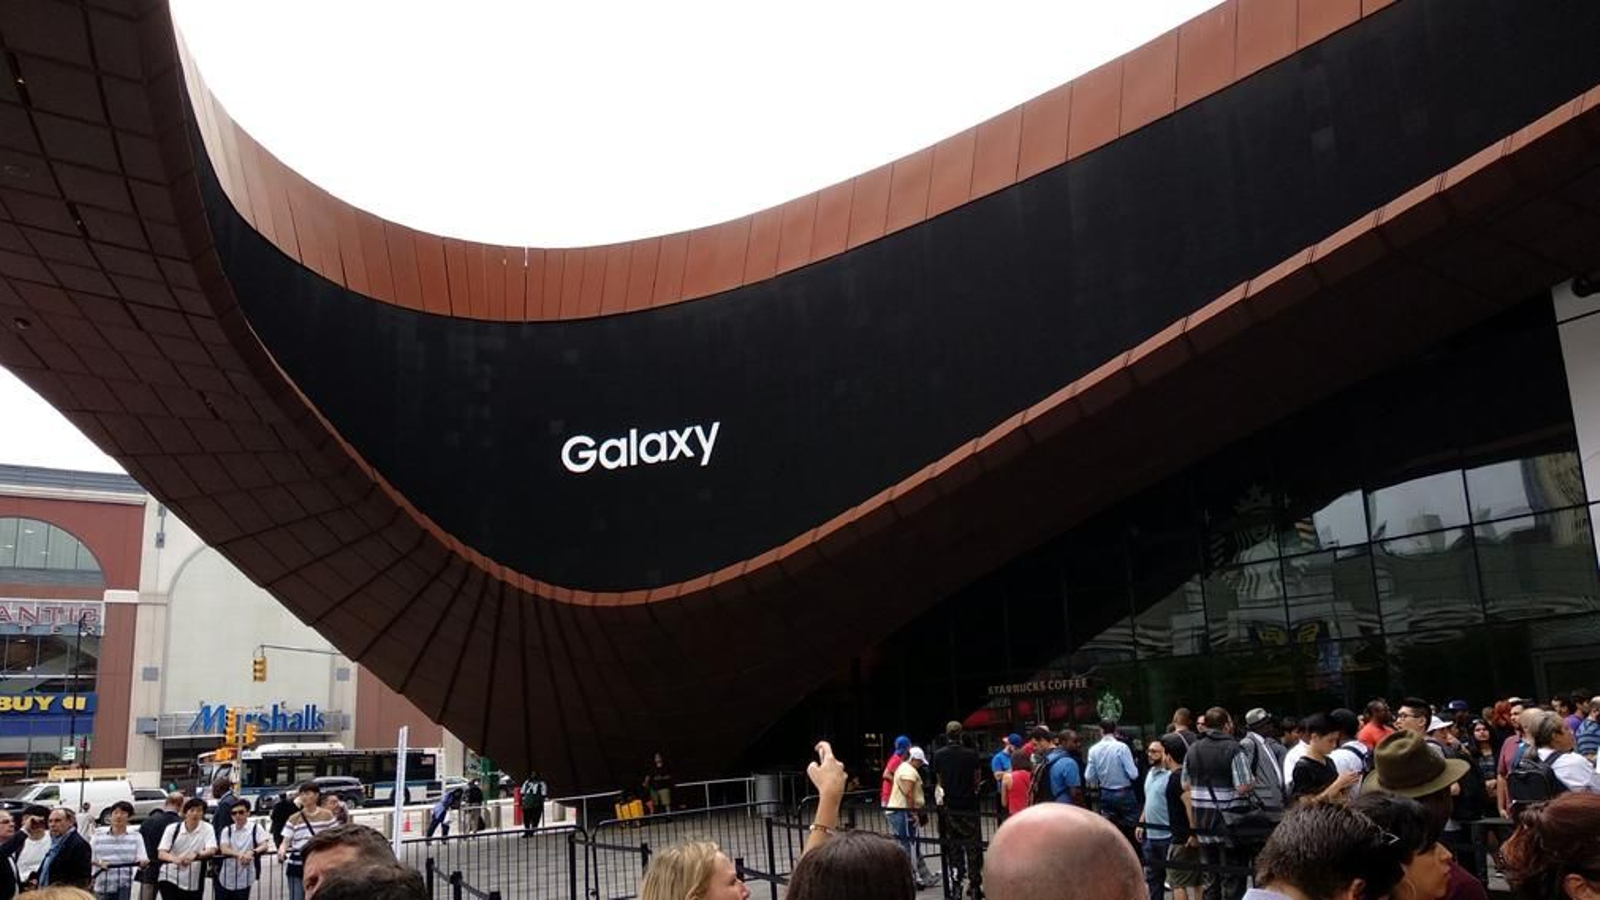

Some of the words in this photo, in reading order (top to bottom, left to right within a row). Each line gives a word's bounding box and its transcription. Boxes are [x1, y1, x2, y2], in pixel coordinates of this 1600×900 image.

[561, 422, 720, 473] Galaxy
[988, 682, 1046, 695] STARBUCKS
[1048, 678, 1088, 690] COFFEE
[0, 695, 57, 711] BUY
[188, 704, 326, 733] Mrshalls
